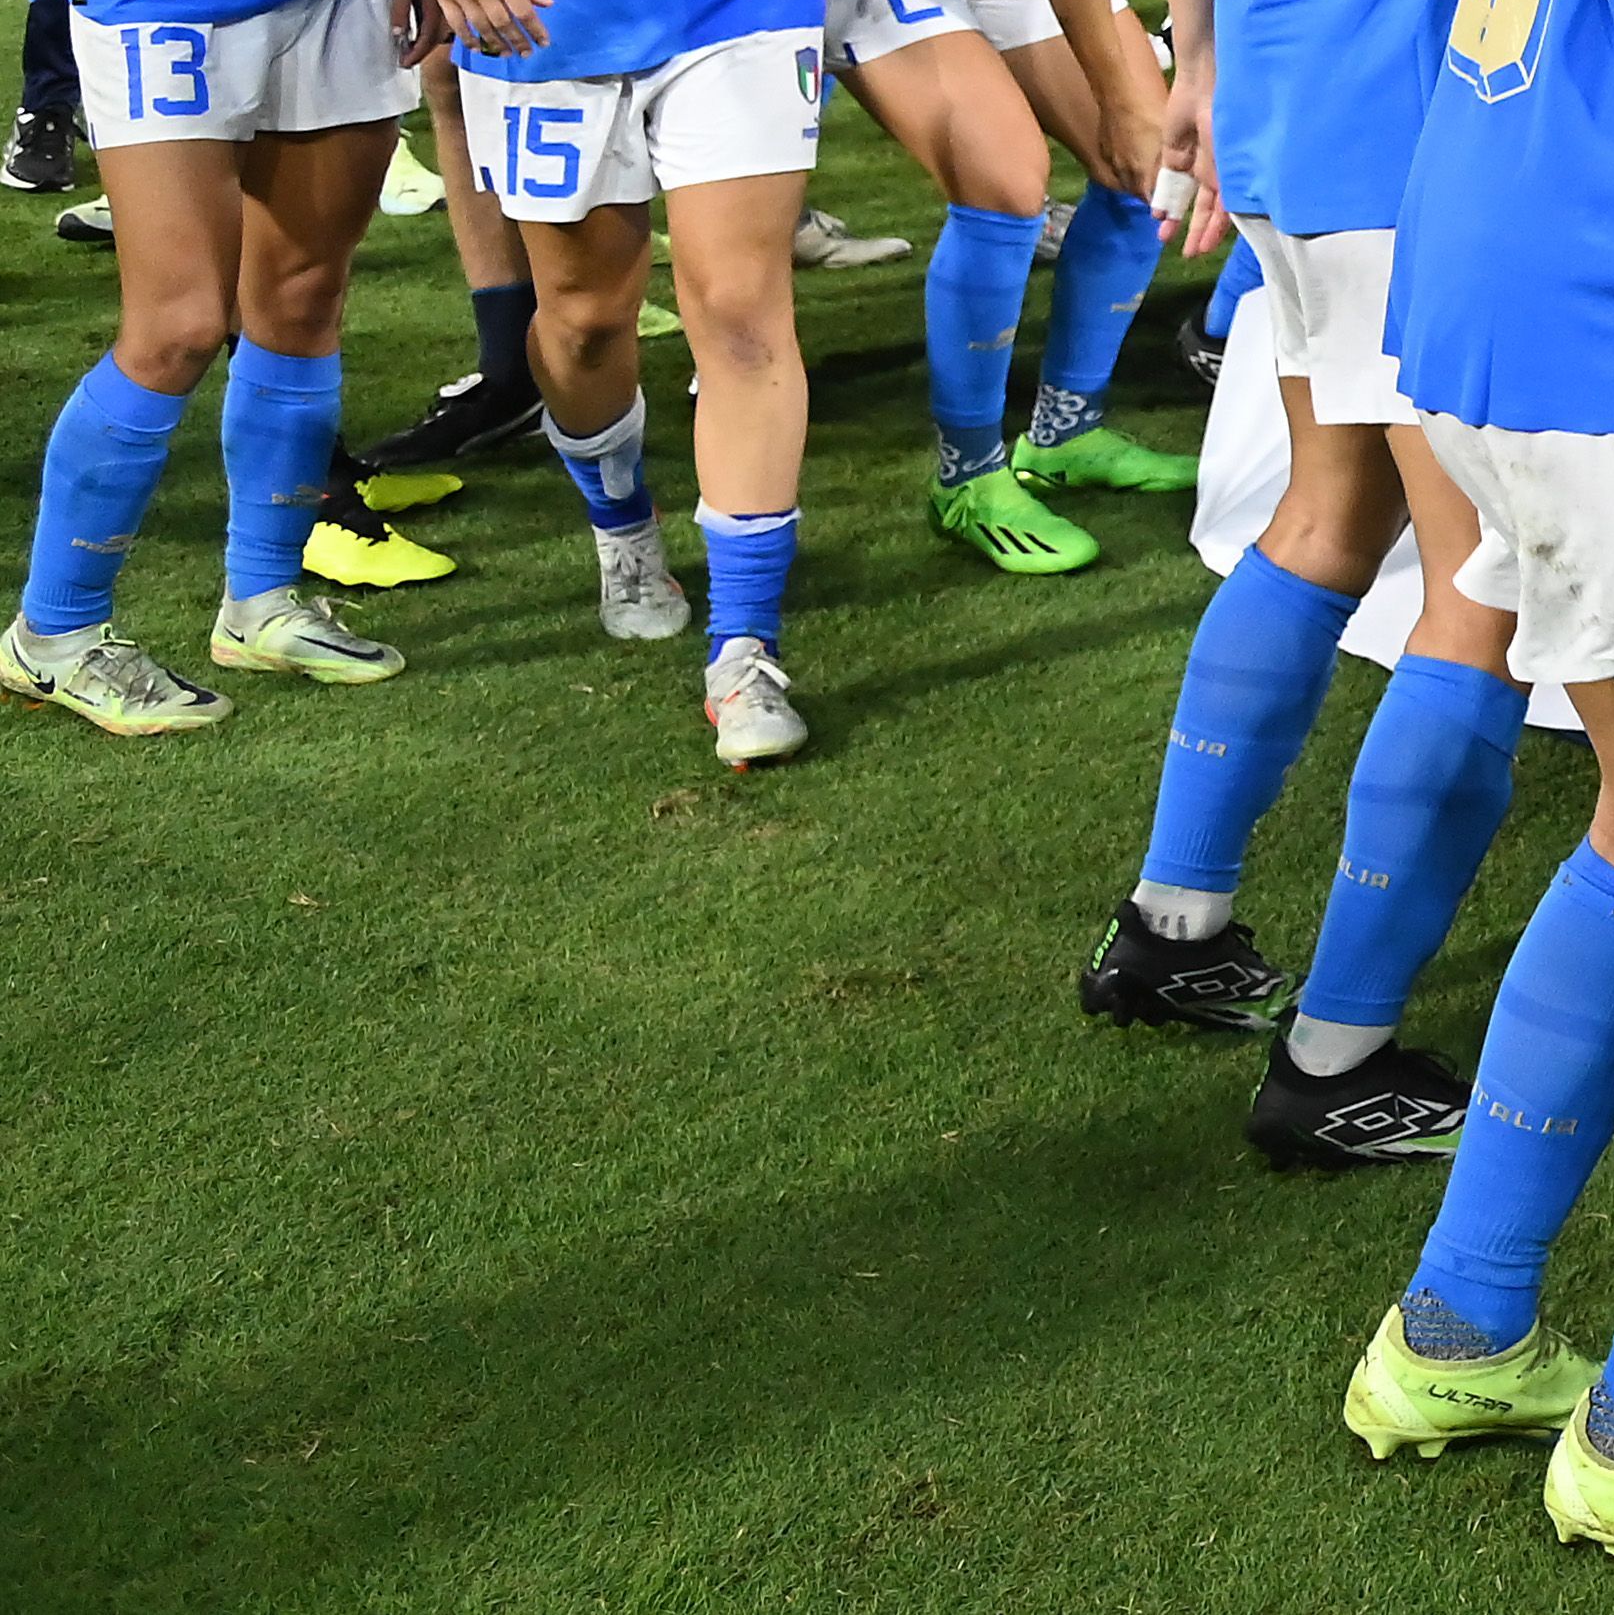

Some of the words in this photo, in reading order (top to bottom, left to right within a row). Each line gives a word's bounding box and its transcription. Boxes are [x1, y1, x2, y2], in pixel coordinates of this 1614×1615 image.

[119, 25, 211, 121] 13
[503, 105, 584, 199] 15
[1168, 727, 1229, 759] ALIA
[1473, 1080, 1579, 1137] TALIA
[1427, 1382, 1513, 1415] ULTRA
